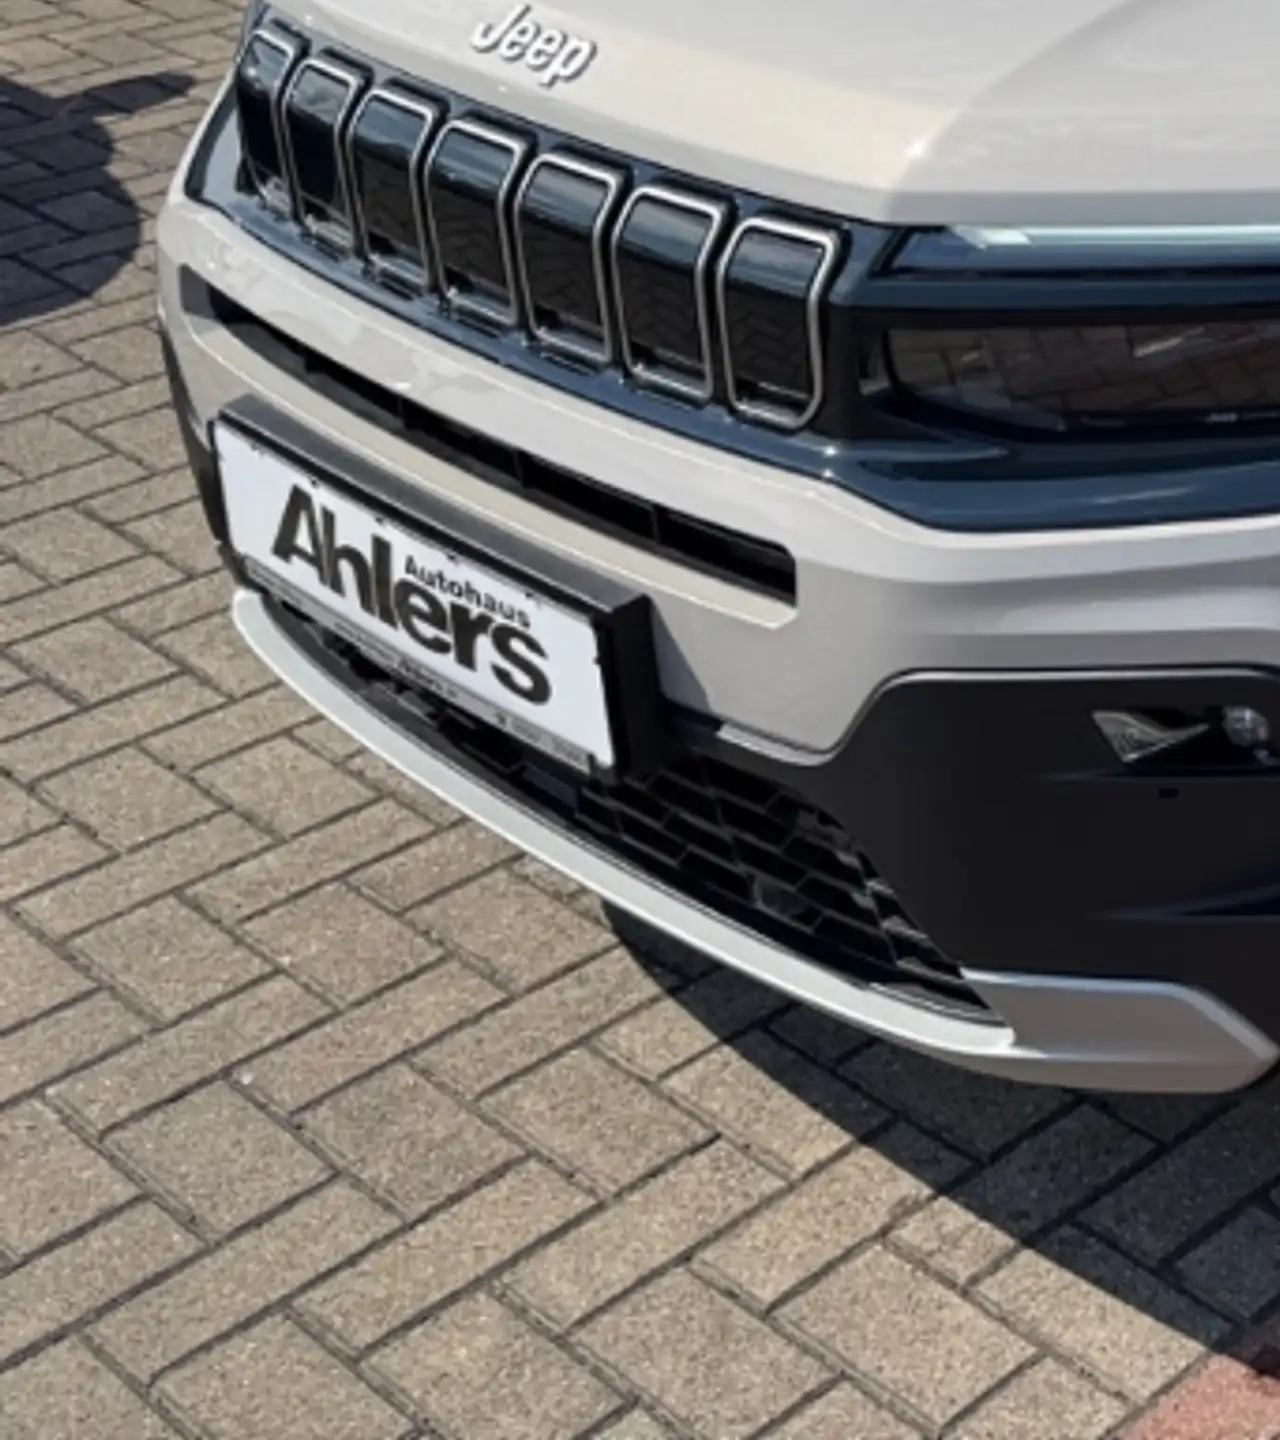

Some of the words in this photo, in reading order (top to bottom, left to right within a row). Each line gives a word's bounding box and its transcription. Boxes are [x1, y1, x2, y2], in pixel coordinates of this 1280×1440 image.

[470, 4, 598, 89] Jeep
[271, 484, 552, 706] Ahlers
[405, 554, 532, 630] Autohaus
